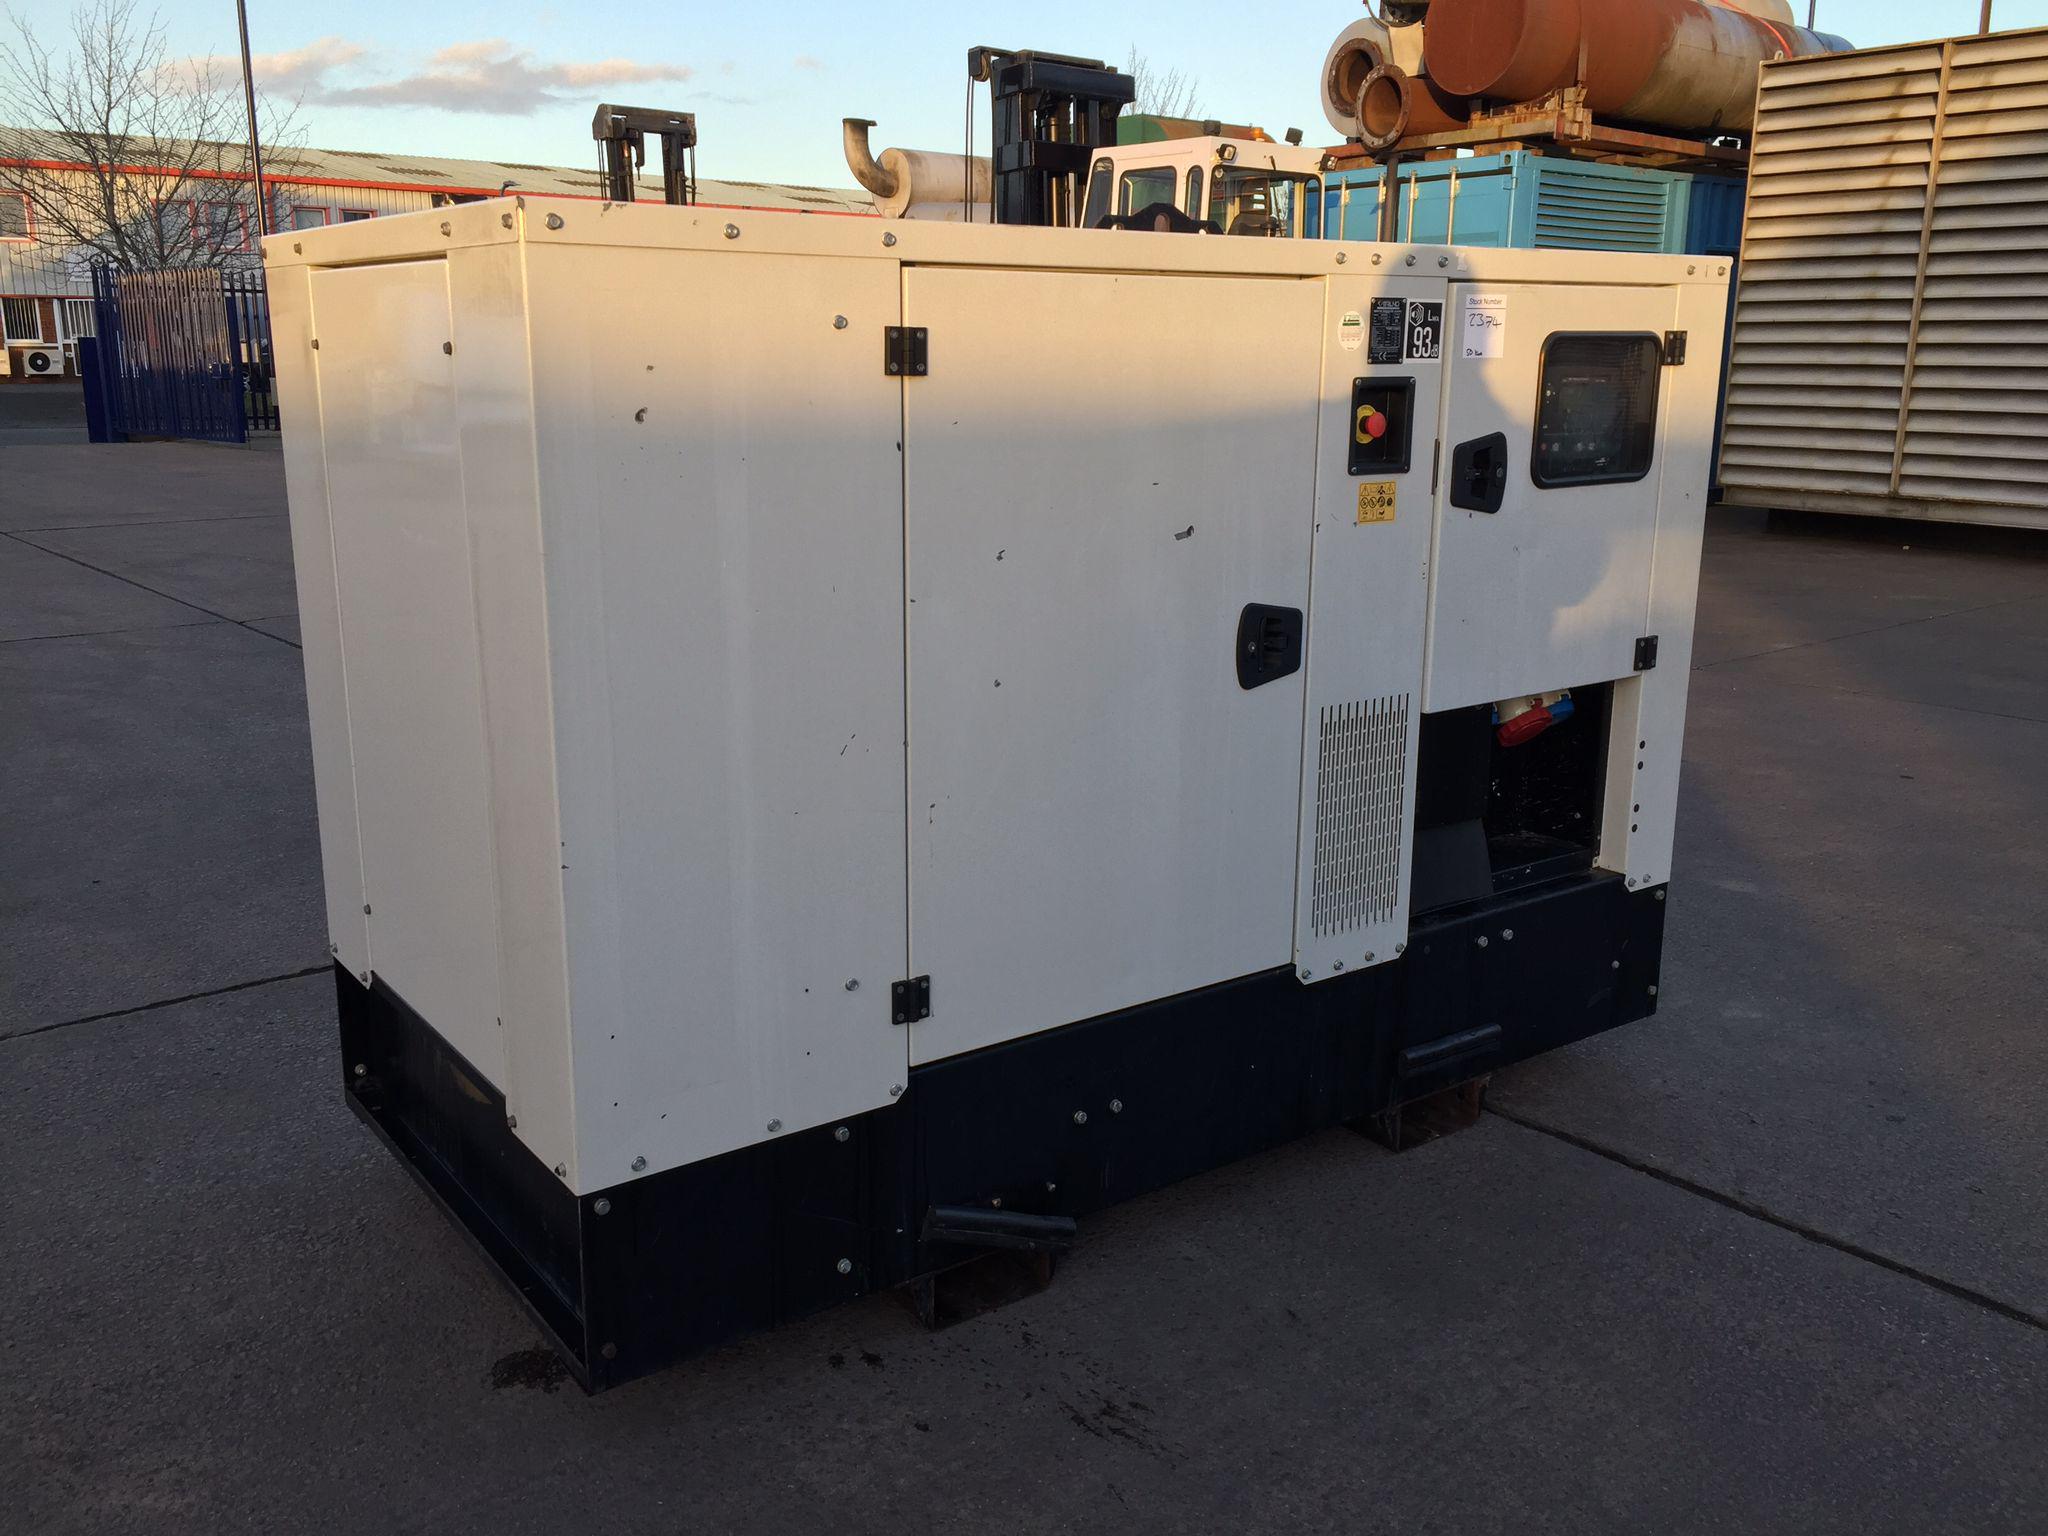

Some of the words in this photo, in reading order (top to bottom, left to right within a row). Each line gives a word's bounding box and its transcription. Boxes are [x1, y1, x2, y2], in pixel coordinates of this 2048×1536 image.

[1468, 297, 1482, 305] Stock
[1484, 297, 1503, 305] Number
[1468, 312, 1503, 329] 2374
[1412, 326, 1433, 358] 93
